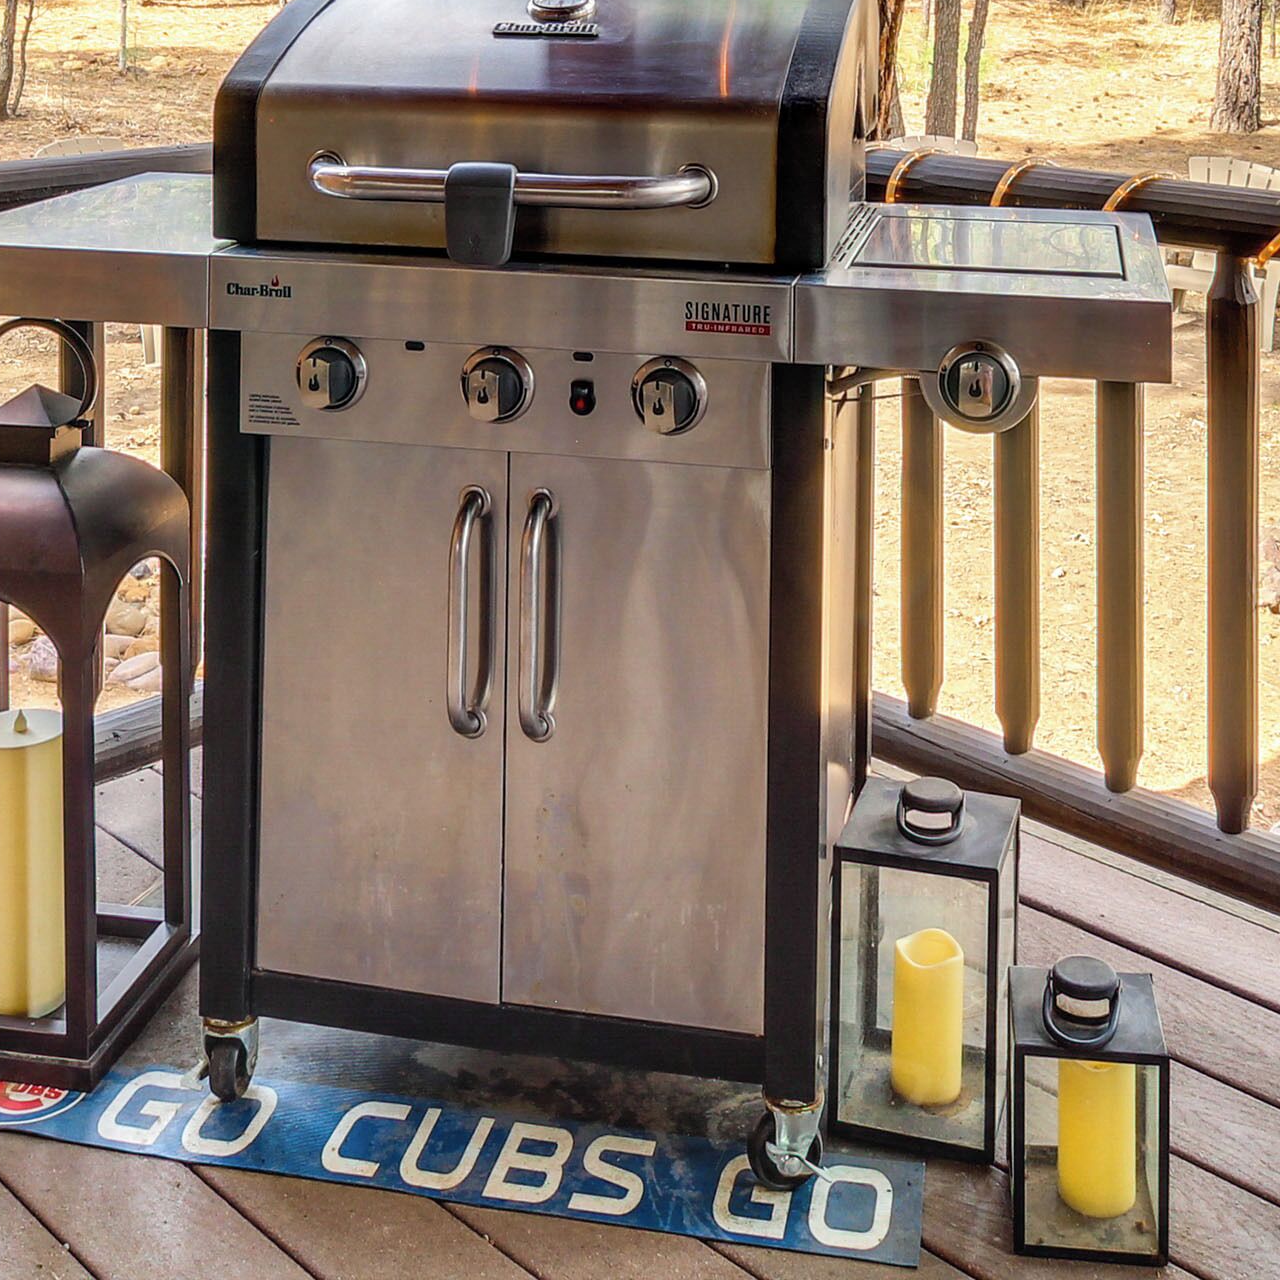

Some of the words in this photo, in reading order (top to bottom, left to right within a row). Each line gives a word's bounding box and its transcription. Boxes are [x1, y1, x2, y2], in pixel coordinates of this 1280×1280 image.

[226, 282, 292, 298] Char-Broil
[685, 301, 771, 324] SIGNATURE
[97, 1071, 278, 1157] GO
[321, 1100, 657, 1216] CUBS
[712, 1153, 894, 1251] GO
